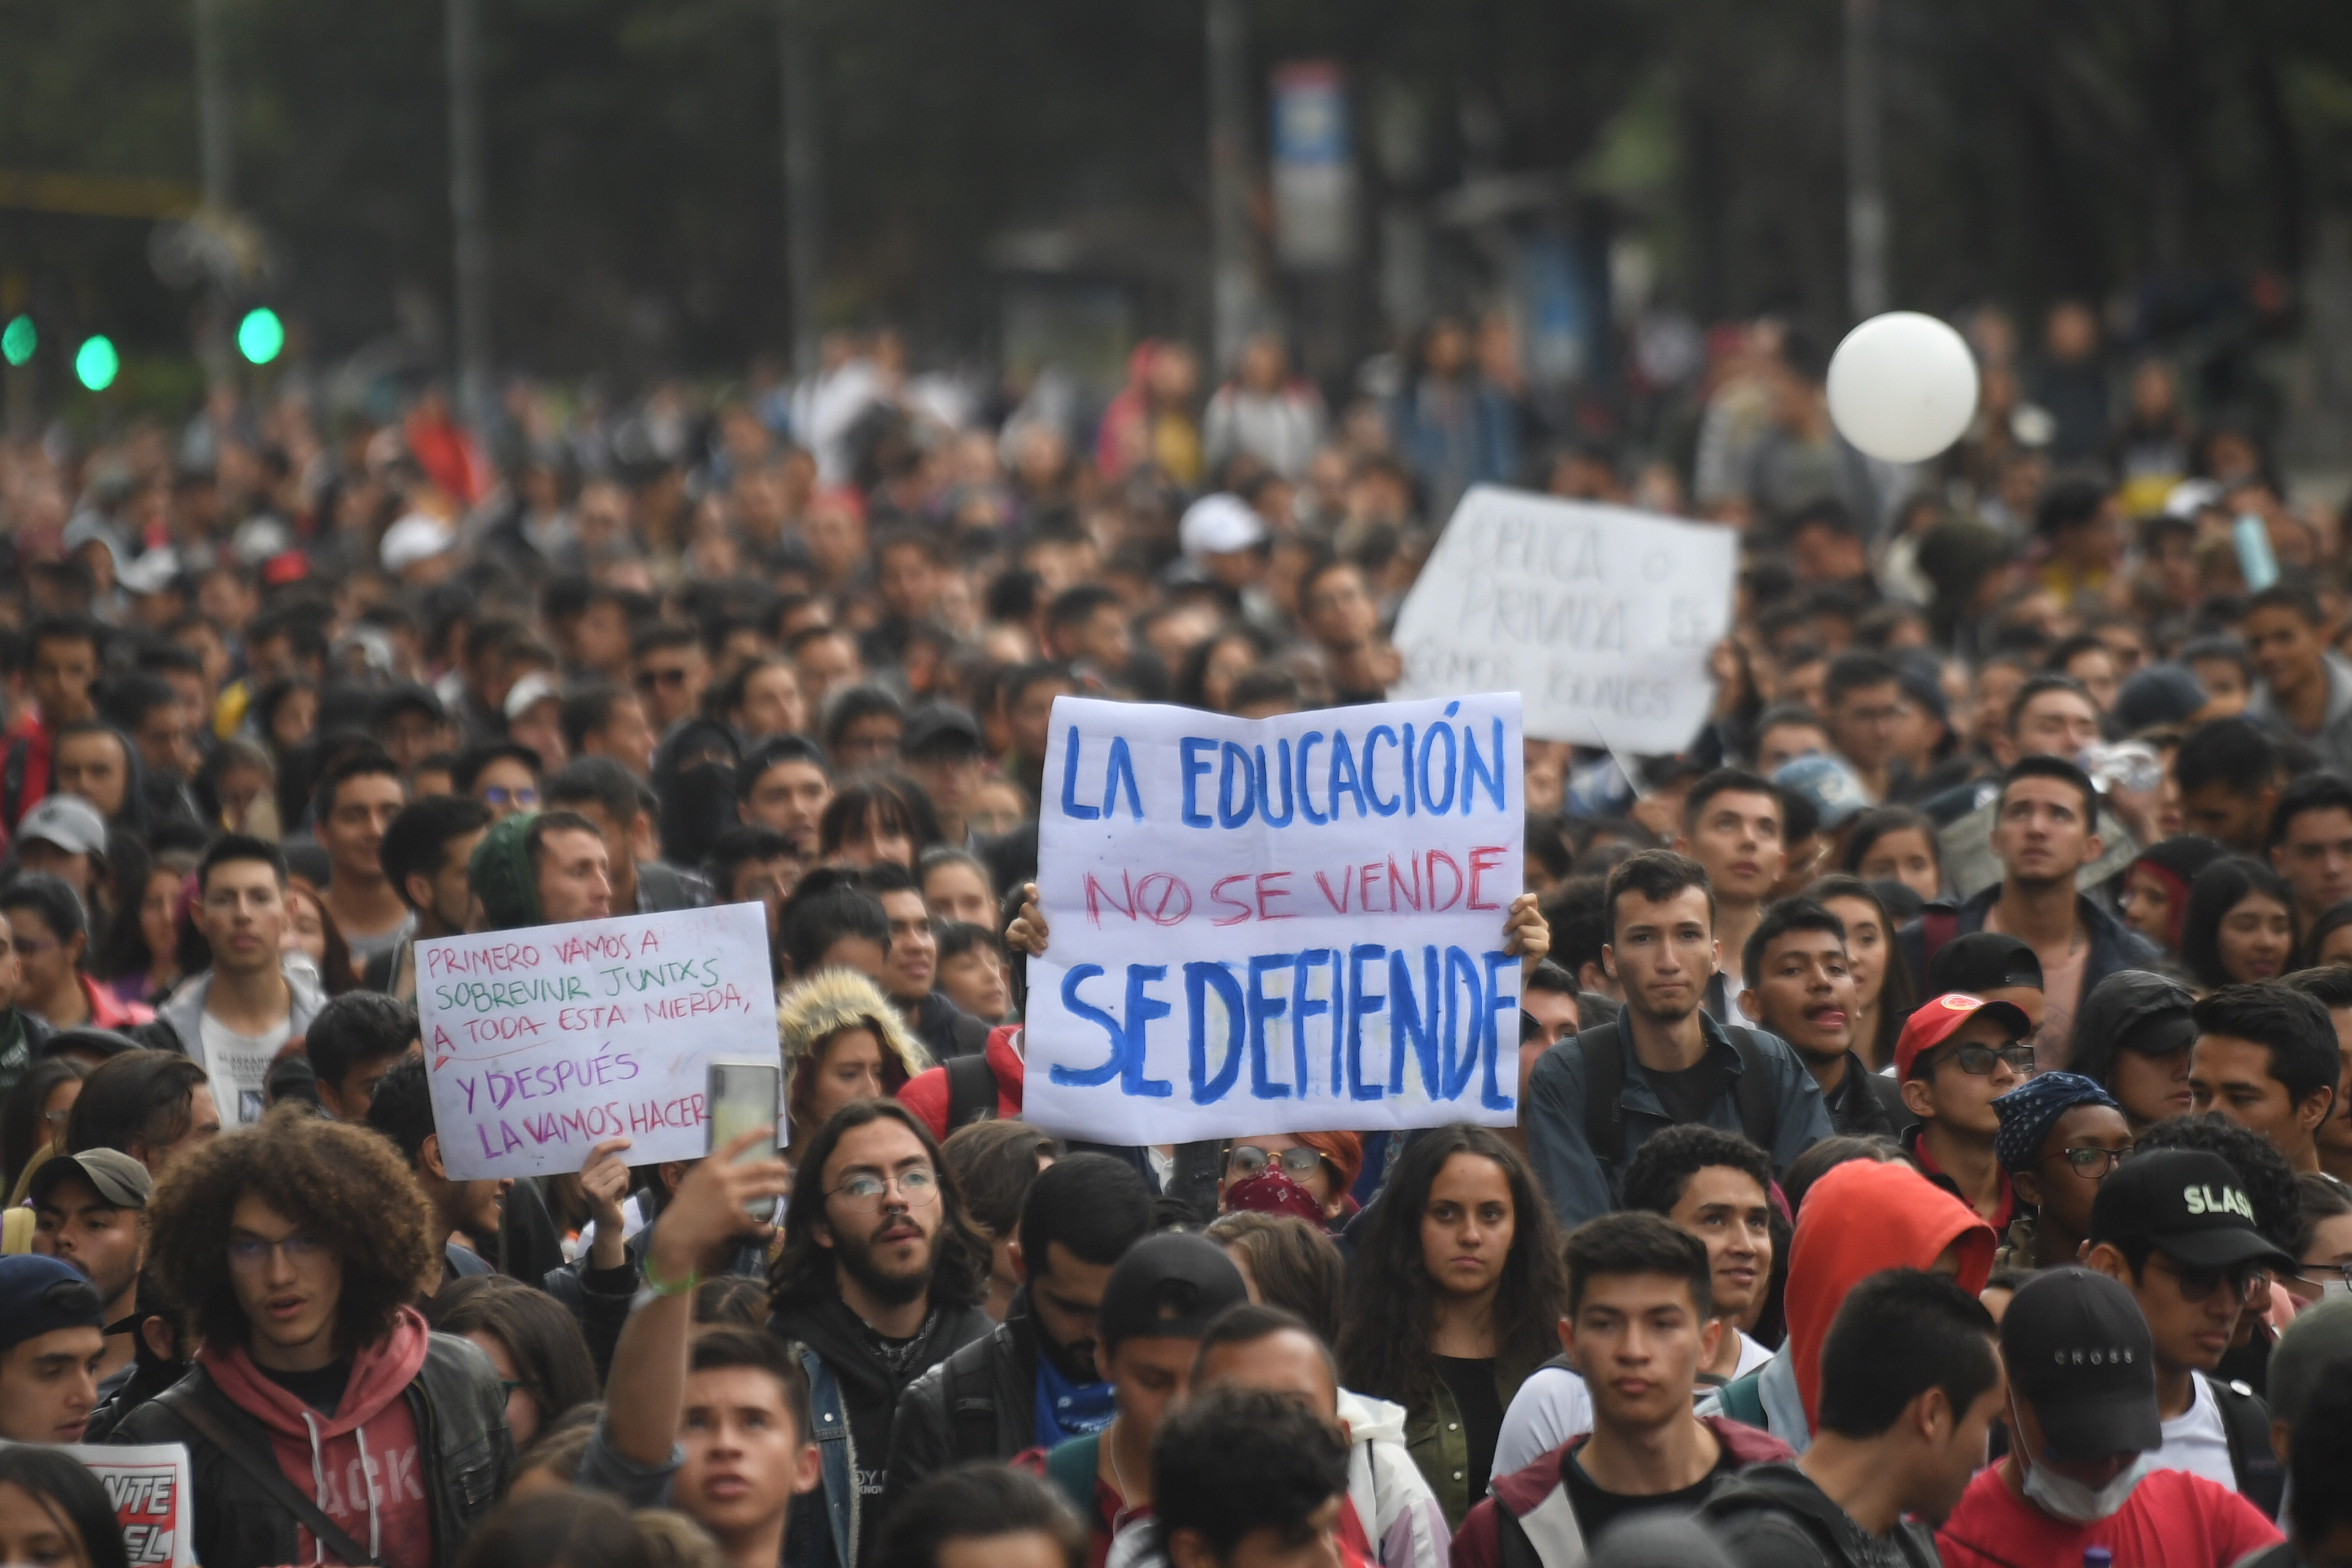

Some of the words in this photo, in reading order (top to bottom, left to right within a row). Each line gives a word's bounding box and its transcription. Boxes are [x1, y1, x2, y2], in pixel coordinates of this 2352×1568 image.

[1061, 725, 1145, 824] LA
[1180, 701, 1505, 829] EDUCACIÓN
[1210, 871, 1297, 927] SE
[1314, 846, 1509, 916] VENDE
[427, 943, 540, 979] PRIMERO
[553, 933, 631, 965] VAMOS
[640, 930, 658, 955] A
[600, 958, 718, 997] JUNTXS
[434, 1025, 456, 1052] A
[462, 1016, 546, 1042] TODA
[558, 1005, 626, 1030] ESTA
[628, 1093, 711, 1134] HACER
[102, 1474, 173, 1515] NTE
[321, 1446, 424, 1518] ACK
